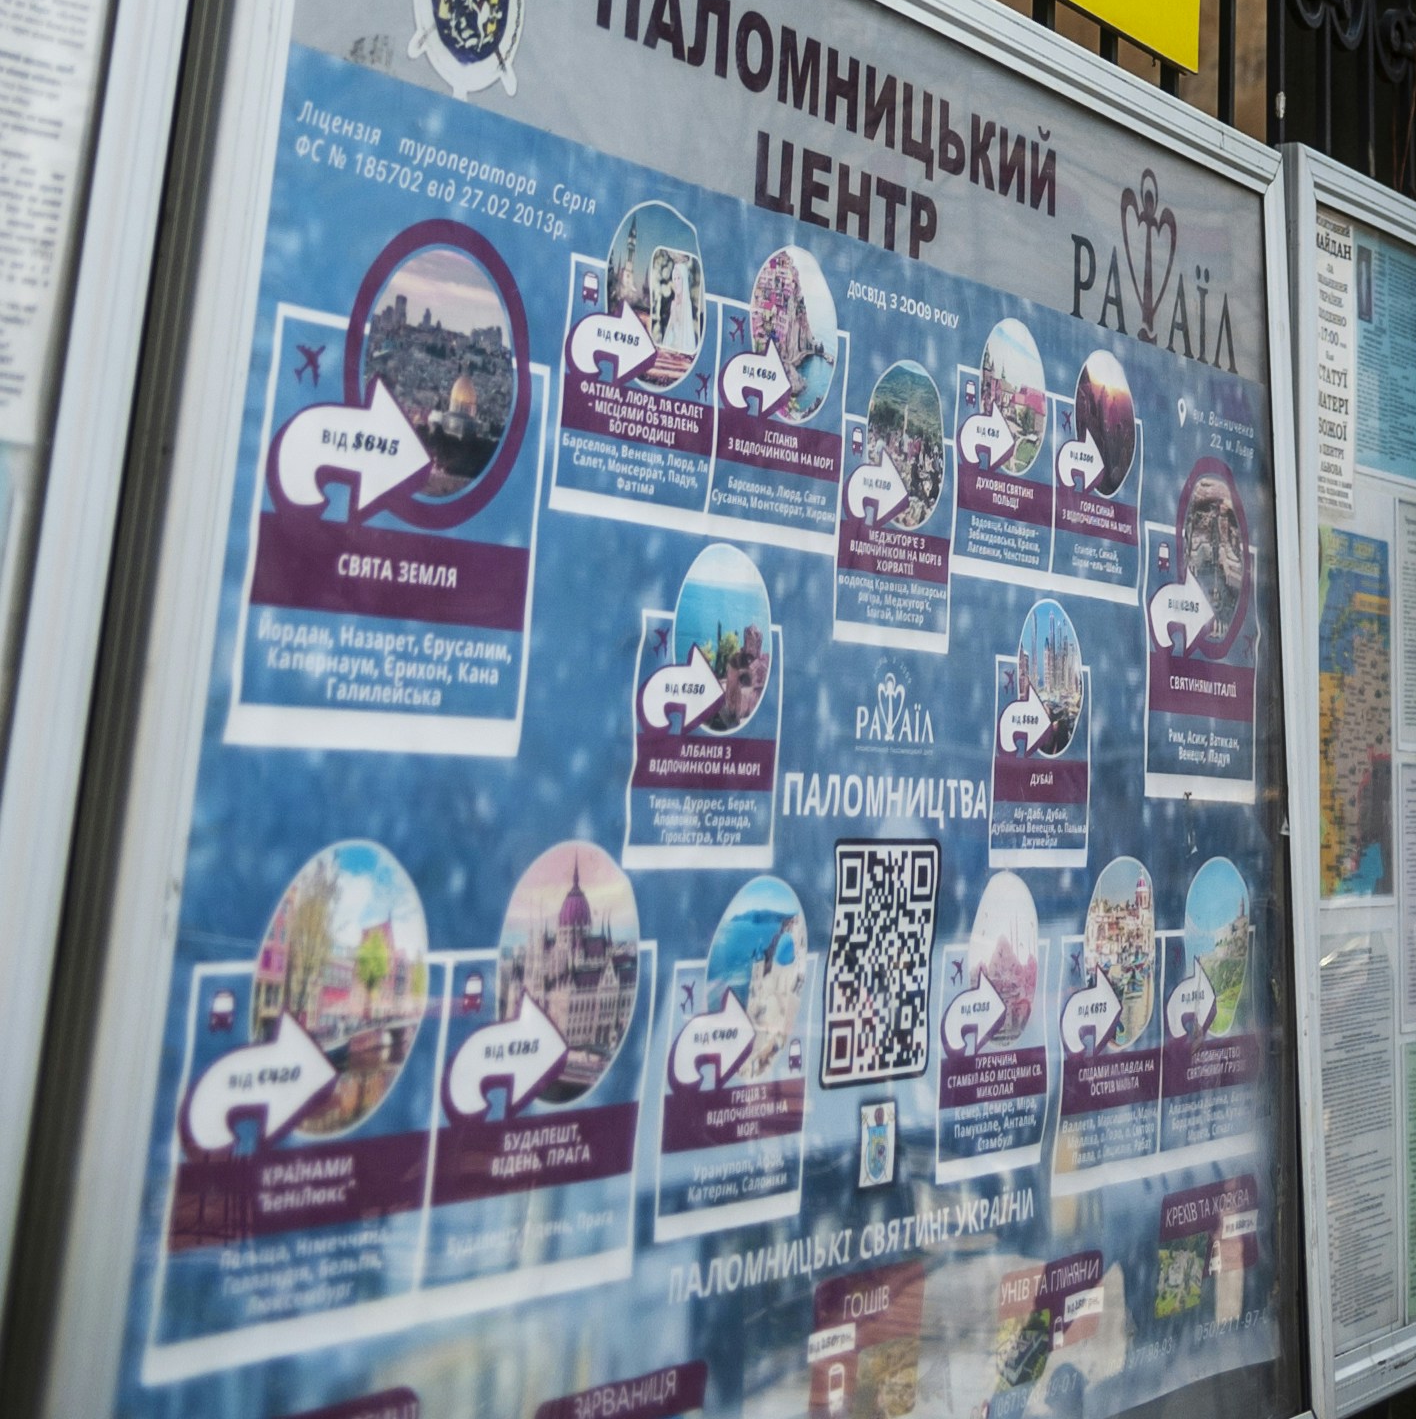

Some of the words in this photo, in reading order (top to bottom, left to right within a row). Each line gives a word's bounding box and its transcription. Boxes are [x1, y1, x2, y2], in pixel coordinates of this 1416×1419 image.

[297, 100, 382, 146] Ліцензія
[399, 137, 538, 197] туроператора
[552, 183, 597, 216] Серія
[295, 134, 325, 163] ФС
[327, 144, 347, 170] №
[354, 153, 424, 193] 185702
[427, 179, 456, 203] від
[460, 186, 510, 220] 27.02
[753, 130, 939, 260] ЦЕНТР
[847, 280, 887, 309] ДОСВІД
[889, 292, 898, 309] З
[900, 295, 932, 321] 2009
[933, 308, 960, 330] РОКУ
[596, 328, 611, 342] ВІД
[742, 364, 755, 378] ВІД
[580, 380, 623, 403] ФАТІМА,
[626, 390, 658, 411] ЛЮРД,
[659, 398, 672, 411] ЛЯ
[674, 401, 704, 420] САЛЕТ
[595, 400, 643, 421] МІСЦЯМИ
[321, 428, 348, 452] ВІД
[351, 430, 400, 456] $645
[609, 419, 676, 446] БОГОРОДИЦІ
[764, 430, 799, 449] ІСПАНІЯ
[562, 433, 618, 457] Барселона,
[697, 460, 709, 474] Ля
[727, 436, 733, 450] З
[734, 439, 799, 463] ВІДПОЧИНКОМ
[800, 452, 813, 465] НА
[813, 455, 834, 471] МОРІ
[573, 452, 606, 471] Салет,
[608, 458, 667, 482] Монсеррат,
[617, 476, 655, 495] Фатіма
[728, 475, 774, 497] Барселона,
[976, 476, 1006, 492] ДУХОВНІ
[1007, 483, 1034, 499] СВЯТИНІ
[992, 493, 1019, 510] ПОЛЬЩІ
[1080, 500, 1095, 514] ГОРА
[1110, 519, 1118, 530] НА
[849, 539, 906, 560] ВІДПОЧИНКОМ
[907, 550, 917, 563] НА
[919, 552, 937, 566] МОРІ
[919, 538, 925, 550] З
[338, 553, 393, 582] СВЯТА
[398, 563, 458, 589] ЗЕМЛЯ
[340, 624, 419, 656] Назарет,
[423, 633, 512, 664] Єрусалим,
[266, 647, 379, 679] Капернаум,
[384, 656, 453, 687] Єрихон,
[458, 663, 500, 687] Кана
[326, 677, 443, 707] Галилейська
[664, 683, 680, 696] ВІД
[1168, 727, 1186, 745] Рим,
[680, 744, 723, 759] АЛБАНІЯ
[724, 745, 731, 760] З
[649, 759, 720, 776] ВІДПОЧИНКОМ
[722, 762, 736, 775] НА
[737, 762, 760, 776] МОРІ
[1030, 771, 1054, 787] ДУБАЙ
[683, 795, 725, 814] Дуррес,
[728, 797, 757, 812] Берат,
[782, 771, 988, 830] ПАЛОМНИЦТВА
[704, 812, 751, 828] Саранда,
[716, 830, 741, 845] Круя
[975, 1053, 1018, 1069] ТУРЕЧЧИНА
[1144, 1059, 1155, 1072] НА
[979, 1070, 996, 1083] АБО
[997, 1065, 1032, 1083] МІСЦЯМИ
[731, 1087, 759, 1104] ГРЕЦІЯ
[759, 1086, 767, 1100] З
[706, 1103, 775, 1128] ВІДПОЧИНКОМ
[775, 1100, 788, 1115] НА
[504, 1124, 582, 1152] БУДАПЕШТ,
[736, 1121, 759, 1137] МОРІ
[261, 1156, 354, 1188] КРАЇНАМИ
[491, 1150, 543, 1179] ВІДЕНЬ,
[546, 1144, 591, 1167] ПРАГА
[1164, 1201, 1198, 1228] КРЕХІВ
[1198, 1198, 1211, 1219] ТА
[1211, 1188, 1250, 1216] ЖОВКВА
[668, 1228, 853, 1305] ПАЛОМНИЦЬКІ
[859, 1206, 950, 1260] СВЯТИНІ
[953, 1185, 1035, 1239] УКРАЇНИ
[842, 1283, 891, 1321] ГОШІВ
[1000, 1276, 1031, 1306] УНІВ
[1033, 1273, 1049, 1297] ТА
